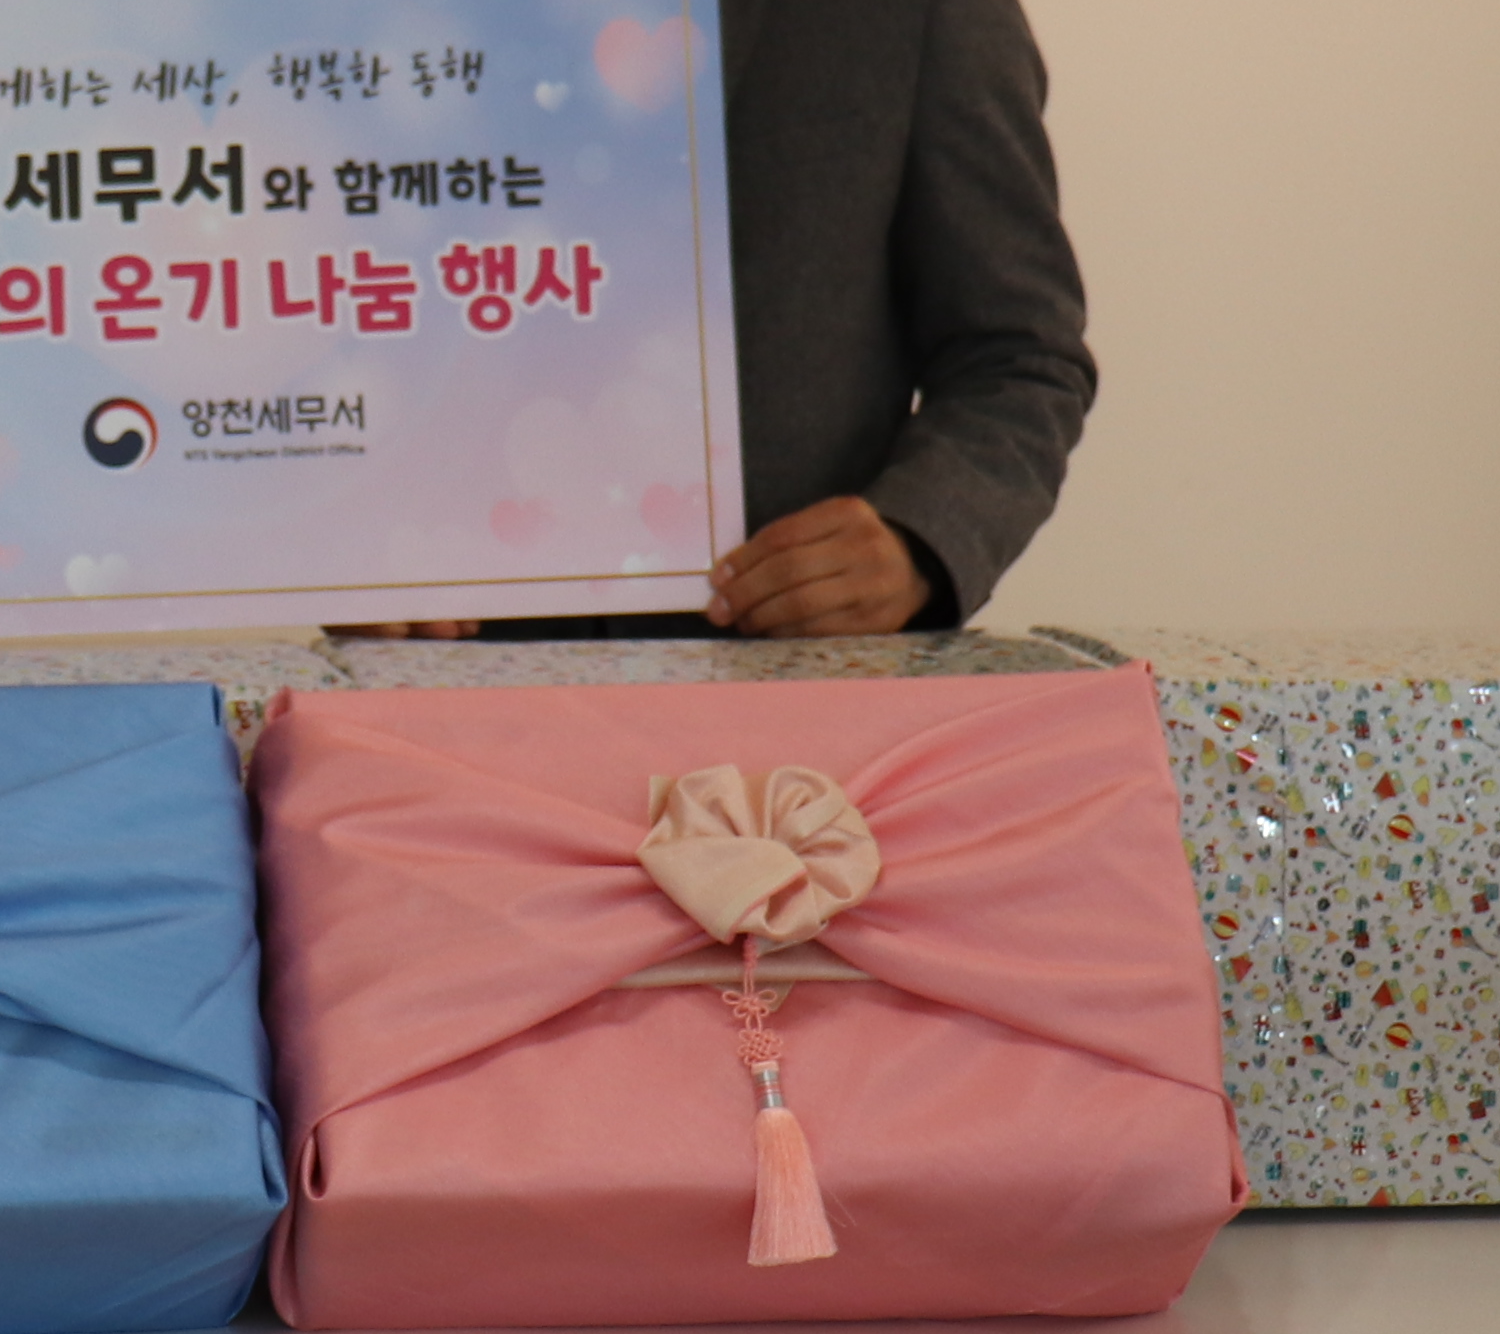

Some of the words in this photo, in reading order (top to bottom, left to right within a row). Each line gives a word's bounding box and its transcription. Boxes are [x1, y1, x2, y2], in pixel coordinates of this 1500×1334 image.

[131, 61, 241, 108] 세상,
[266, 48, 391, 101] 행복한
[409, 46, 486, 98] 동행
[333, 154, 547, 216] 함께하는
[93, 254, 241, 342] 온기
[268, 247, 418, 334] 나눔
[438, 241, 603, 334] 행사
[182, 393, 366, 437] 양천세무서
